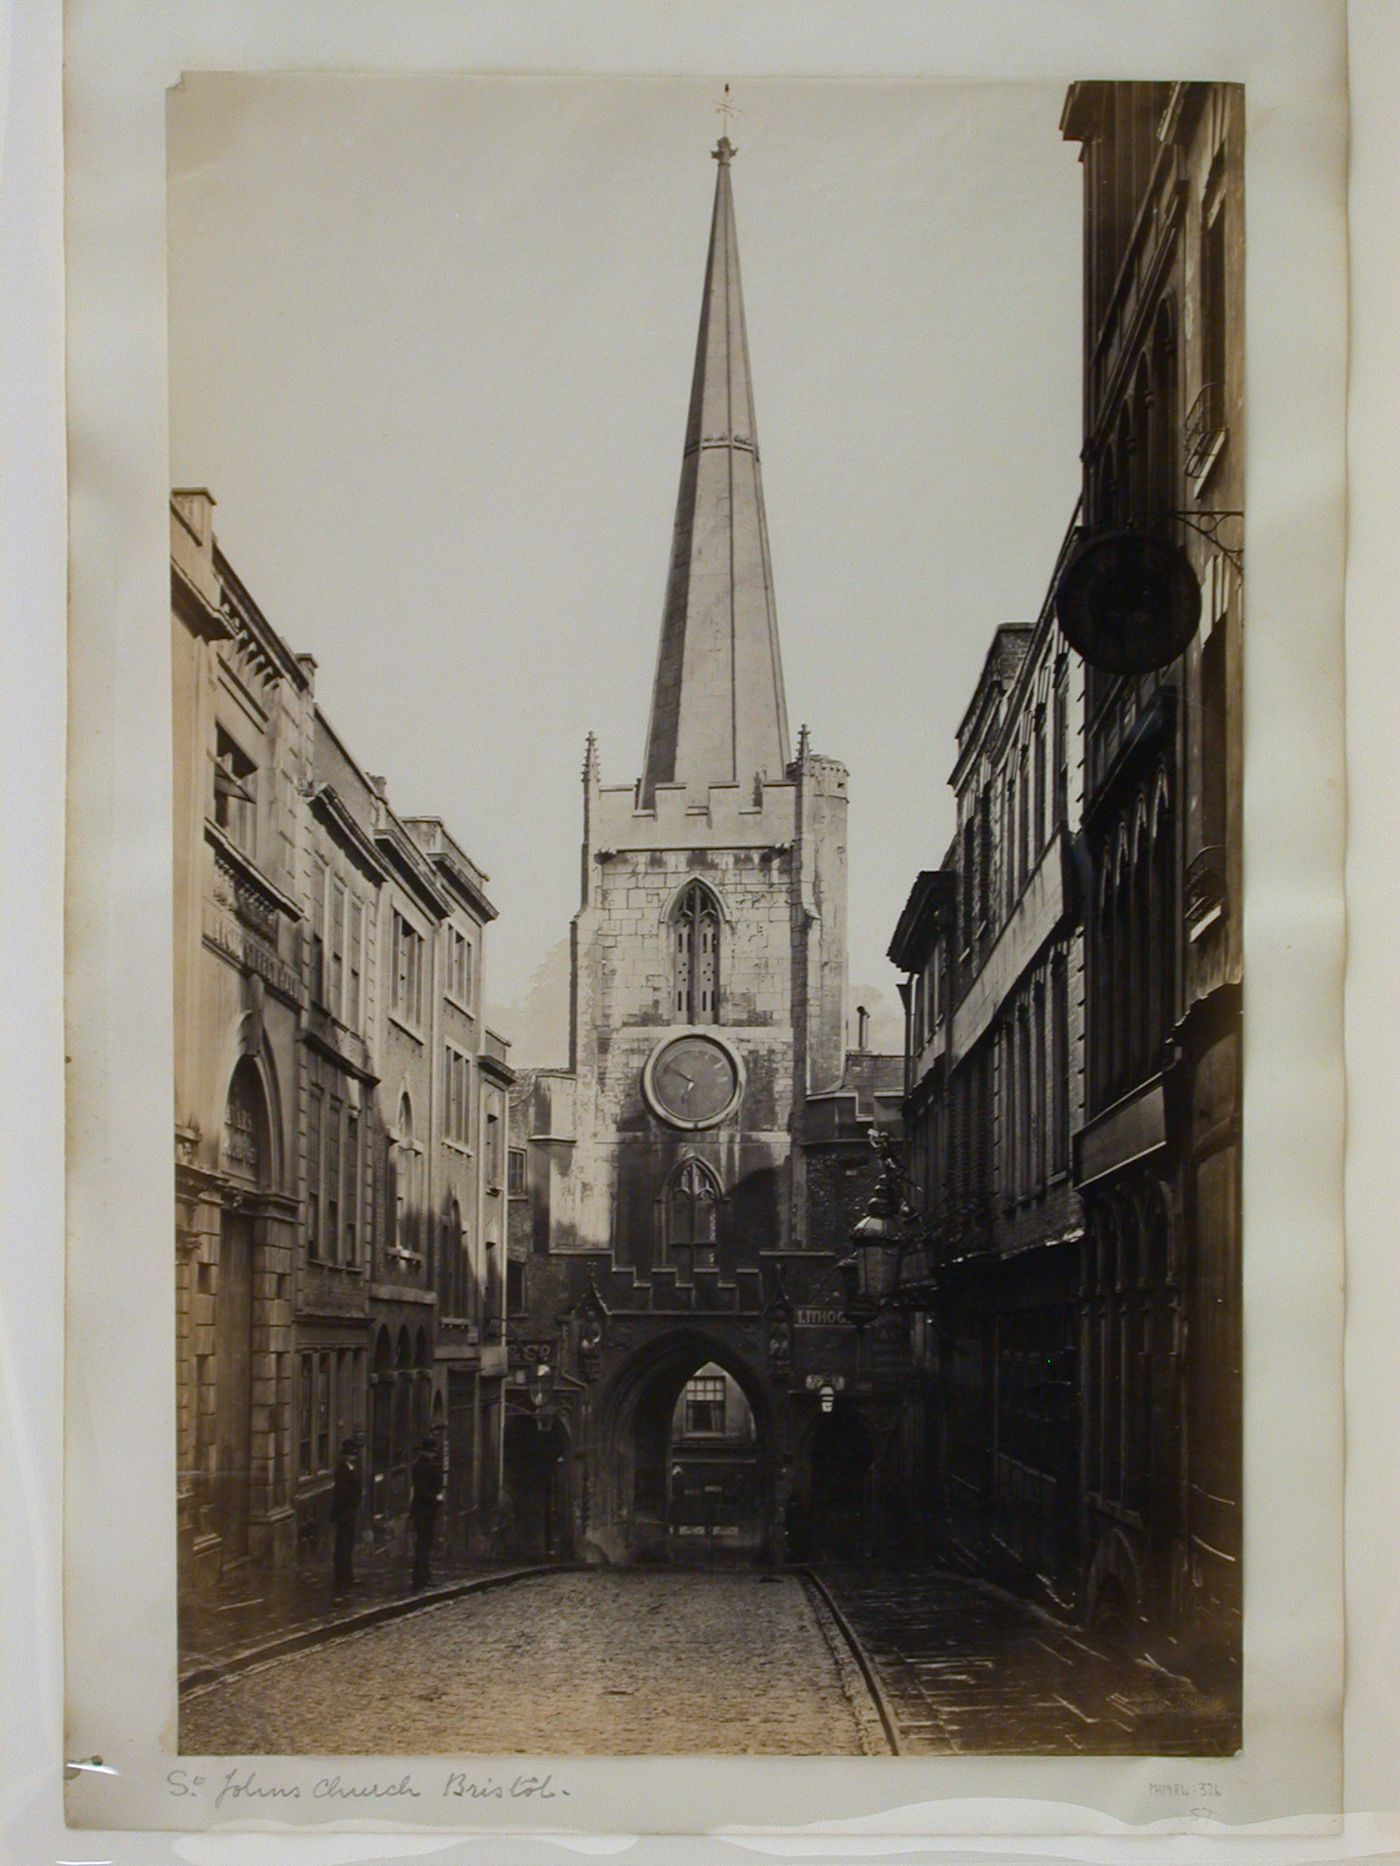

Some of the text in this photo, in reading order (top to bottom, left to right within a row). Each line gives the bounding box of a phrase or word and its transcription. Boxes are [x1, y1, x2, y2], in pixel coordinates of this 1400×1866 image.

[797, 1309, 849, 1325] LITHOG
[214, 1767, 301, 1808] Johns
[313, 1775, 422, 1799] Church
